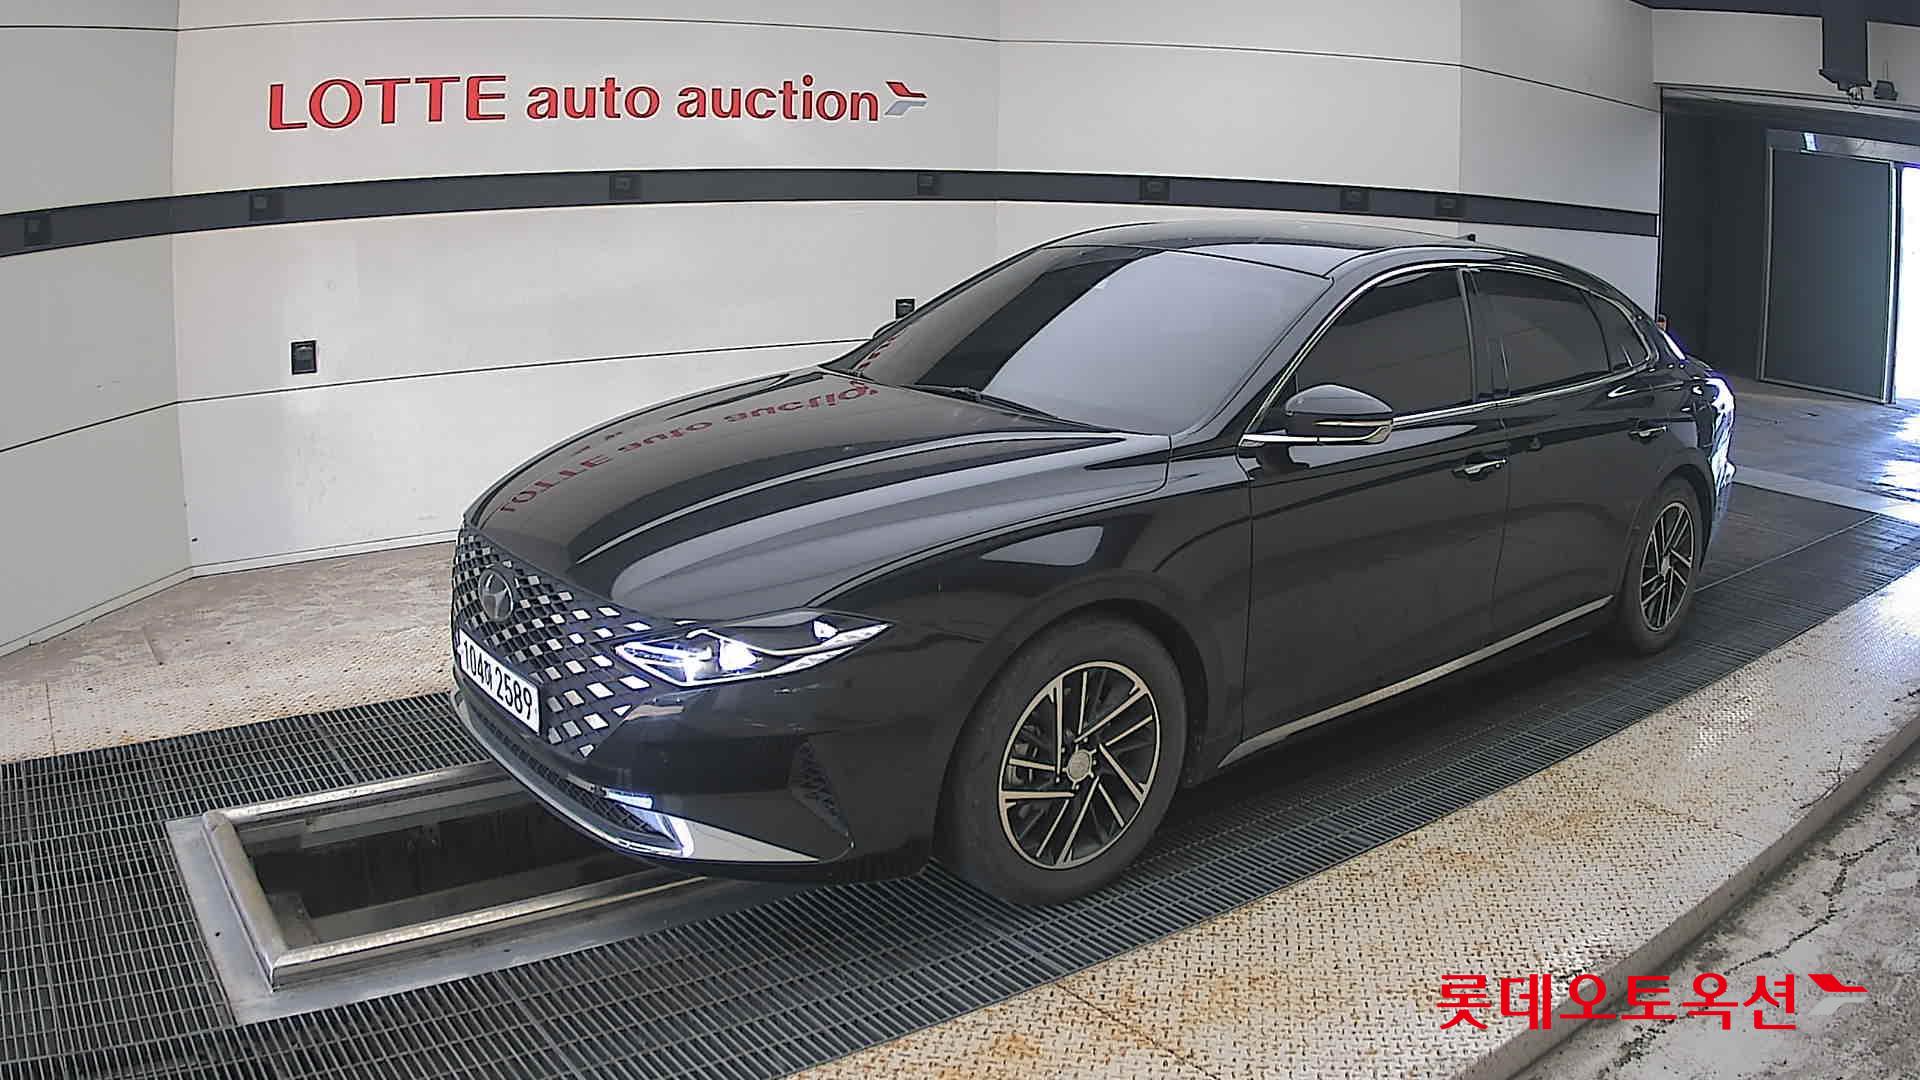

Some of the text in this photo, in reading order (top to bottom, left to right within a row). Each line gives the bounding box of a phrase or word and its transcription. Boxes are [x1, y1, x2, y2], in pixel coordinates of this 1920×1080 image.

[268, 75, 879, 131] LOTTE auto auction
[495, 666, 533, 720] 2589
